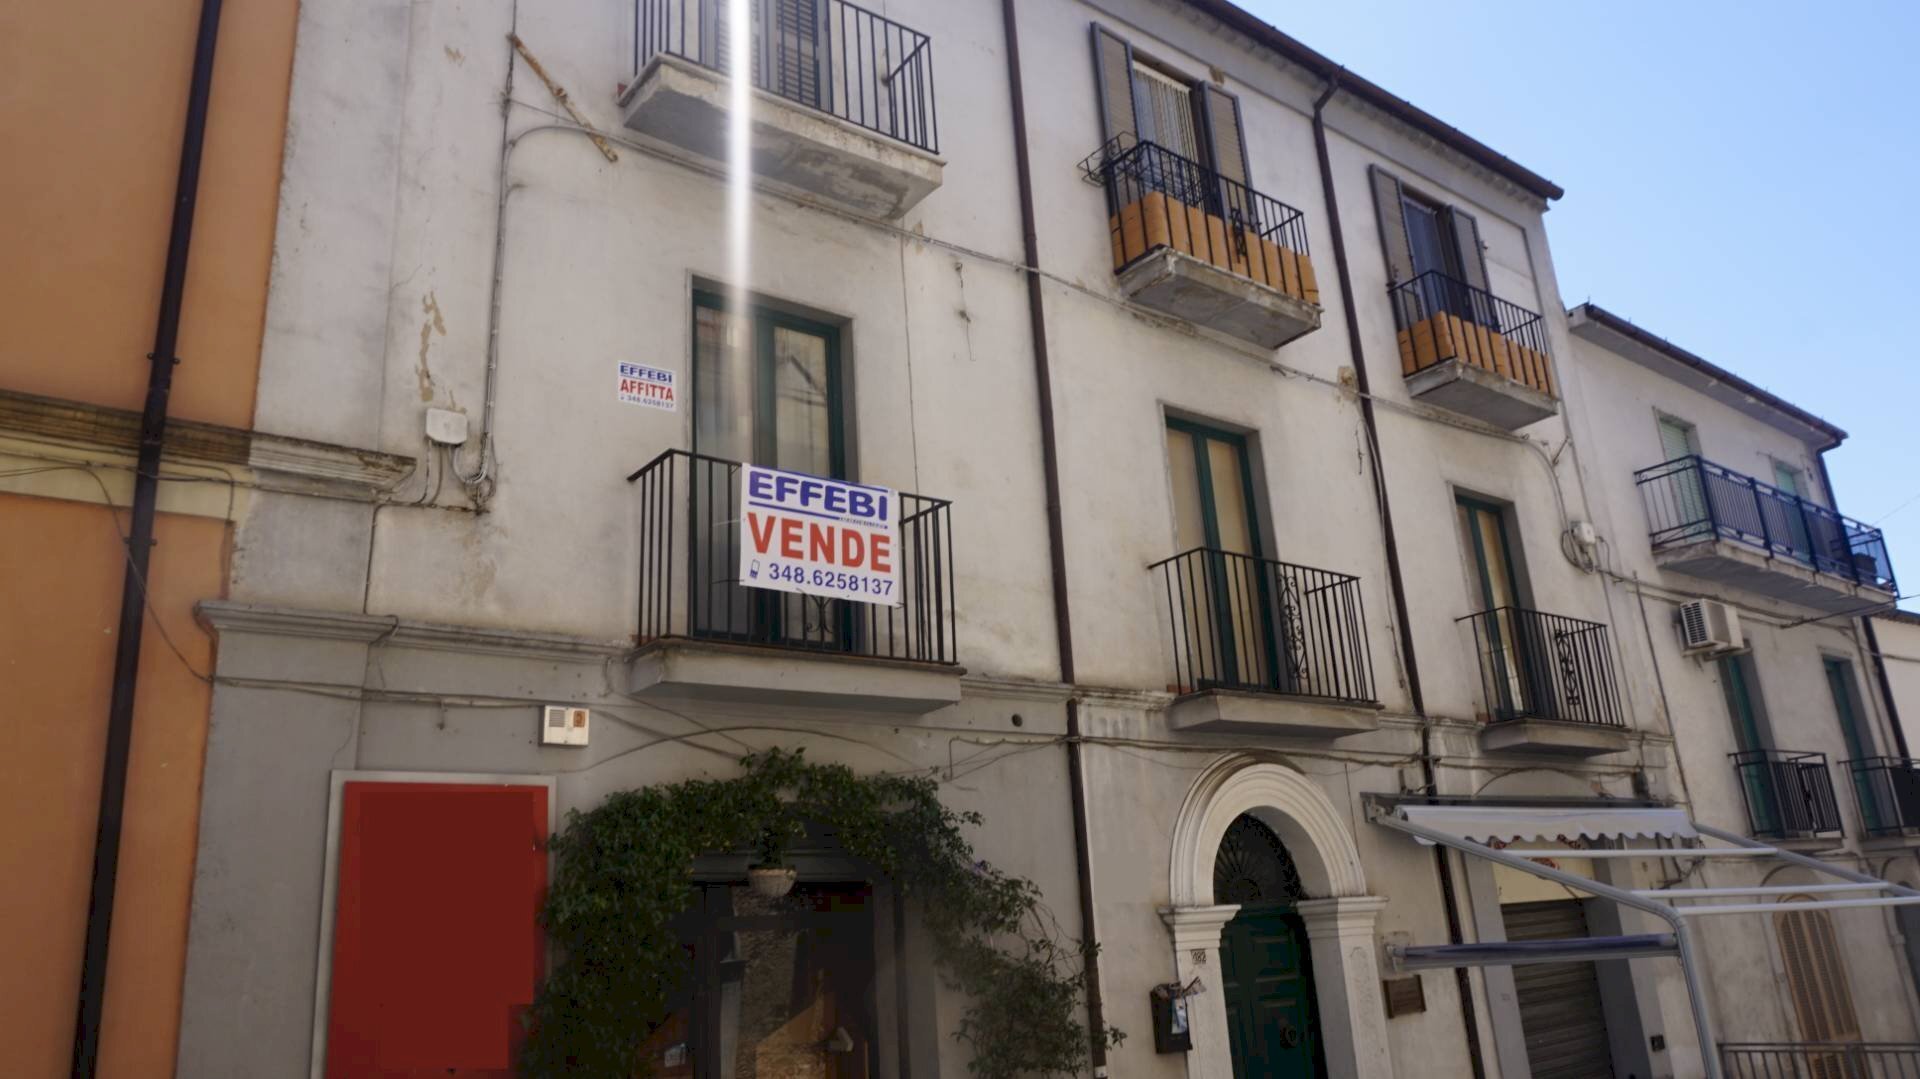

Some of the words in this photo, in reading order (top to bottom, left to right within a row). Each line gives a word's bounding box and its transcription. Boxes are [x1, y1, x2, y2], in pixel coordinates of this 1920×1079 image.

[620, 365, 672, 383] EFFEBI
[621, 379, 674, 402] AFFITTA
[749, 471, 888, 521] EFFEBI
[747, 512, 891, 573] VENDE
[769, 563, 893, 595] 348.6258137
